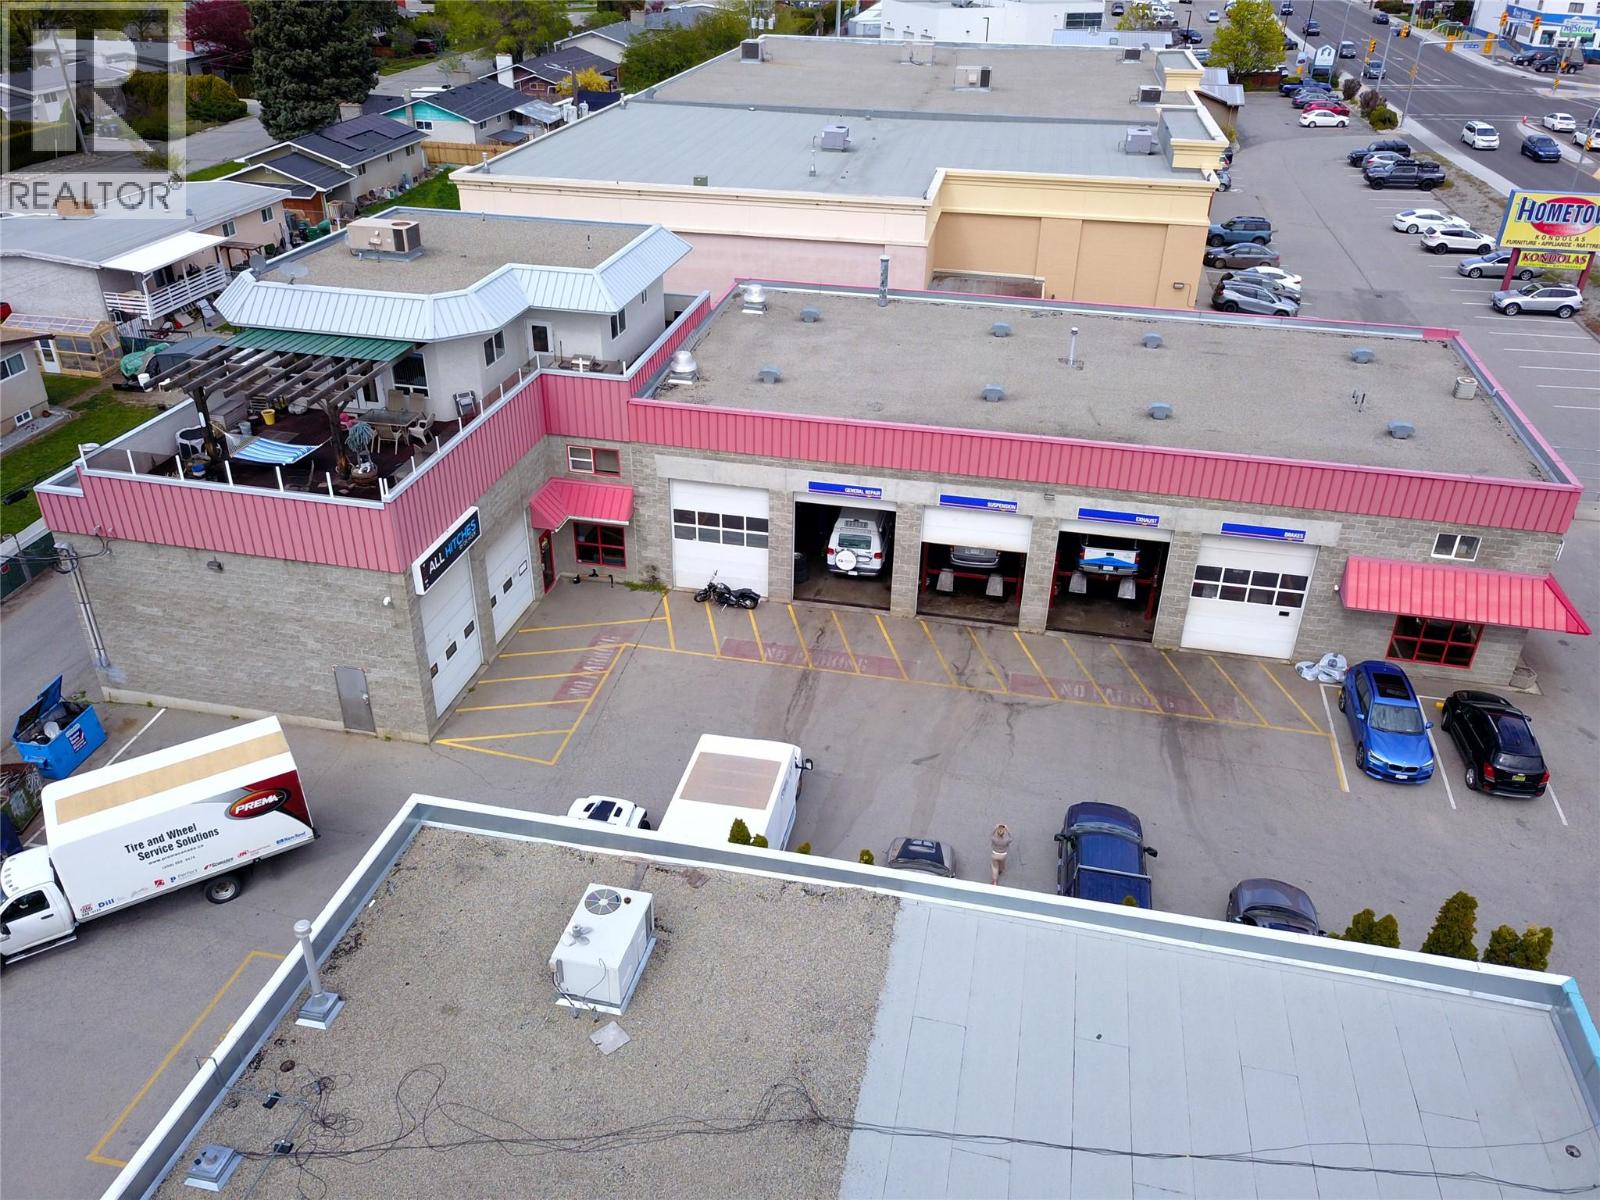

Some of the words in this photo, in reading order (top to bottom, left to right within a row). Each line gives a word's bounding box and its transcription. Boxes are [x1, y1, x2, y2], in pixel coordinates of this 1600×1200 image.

[1534, 234, 1587, 242] KONDOLAS
[1522, 252, 1588, 265] KONDOLAS
[864, 489, 882, 497] REPAIR
[987, 502, 1017, 510] SUSPENSION
[1135, 516, 1158, 525] EXHAUST
[1284, 531, 1304, 540] BRAKES
[429, 552, 446, 574] ALL
[444, 519, 477, 558] HITCHES
[766, 646, 787, 661] NO
[1061, 683, 1086, 698] NO
[235, 794, 279, 815] PREMA
[124, 841, 145, 855] Tire
[146, 833, 166, 848] and
[166, 823, 198, 841] Wheel
[137, 844, 175, 862] Service
[176, 827, 220, 849] Solutions
[97, 898, 115, 909] Dill
